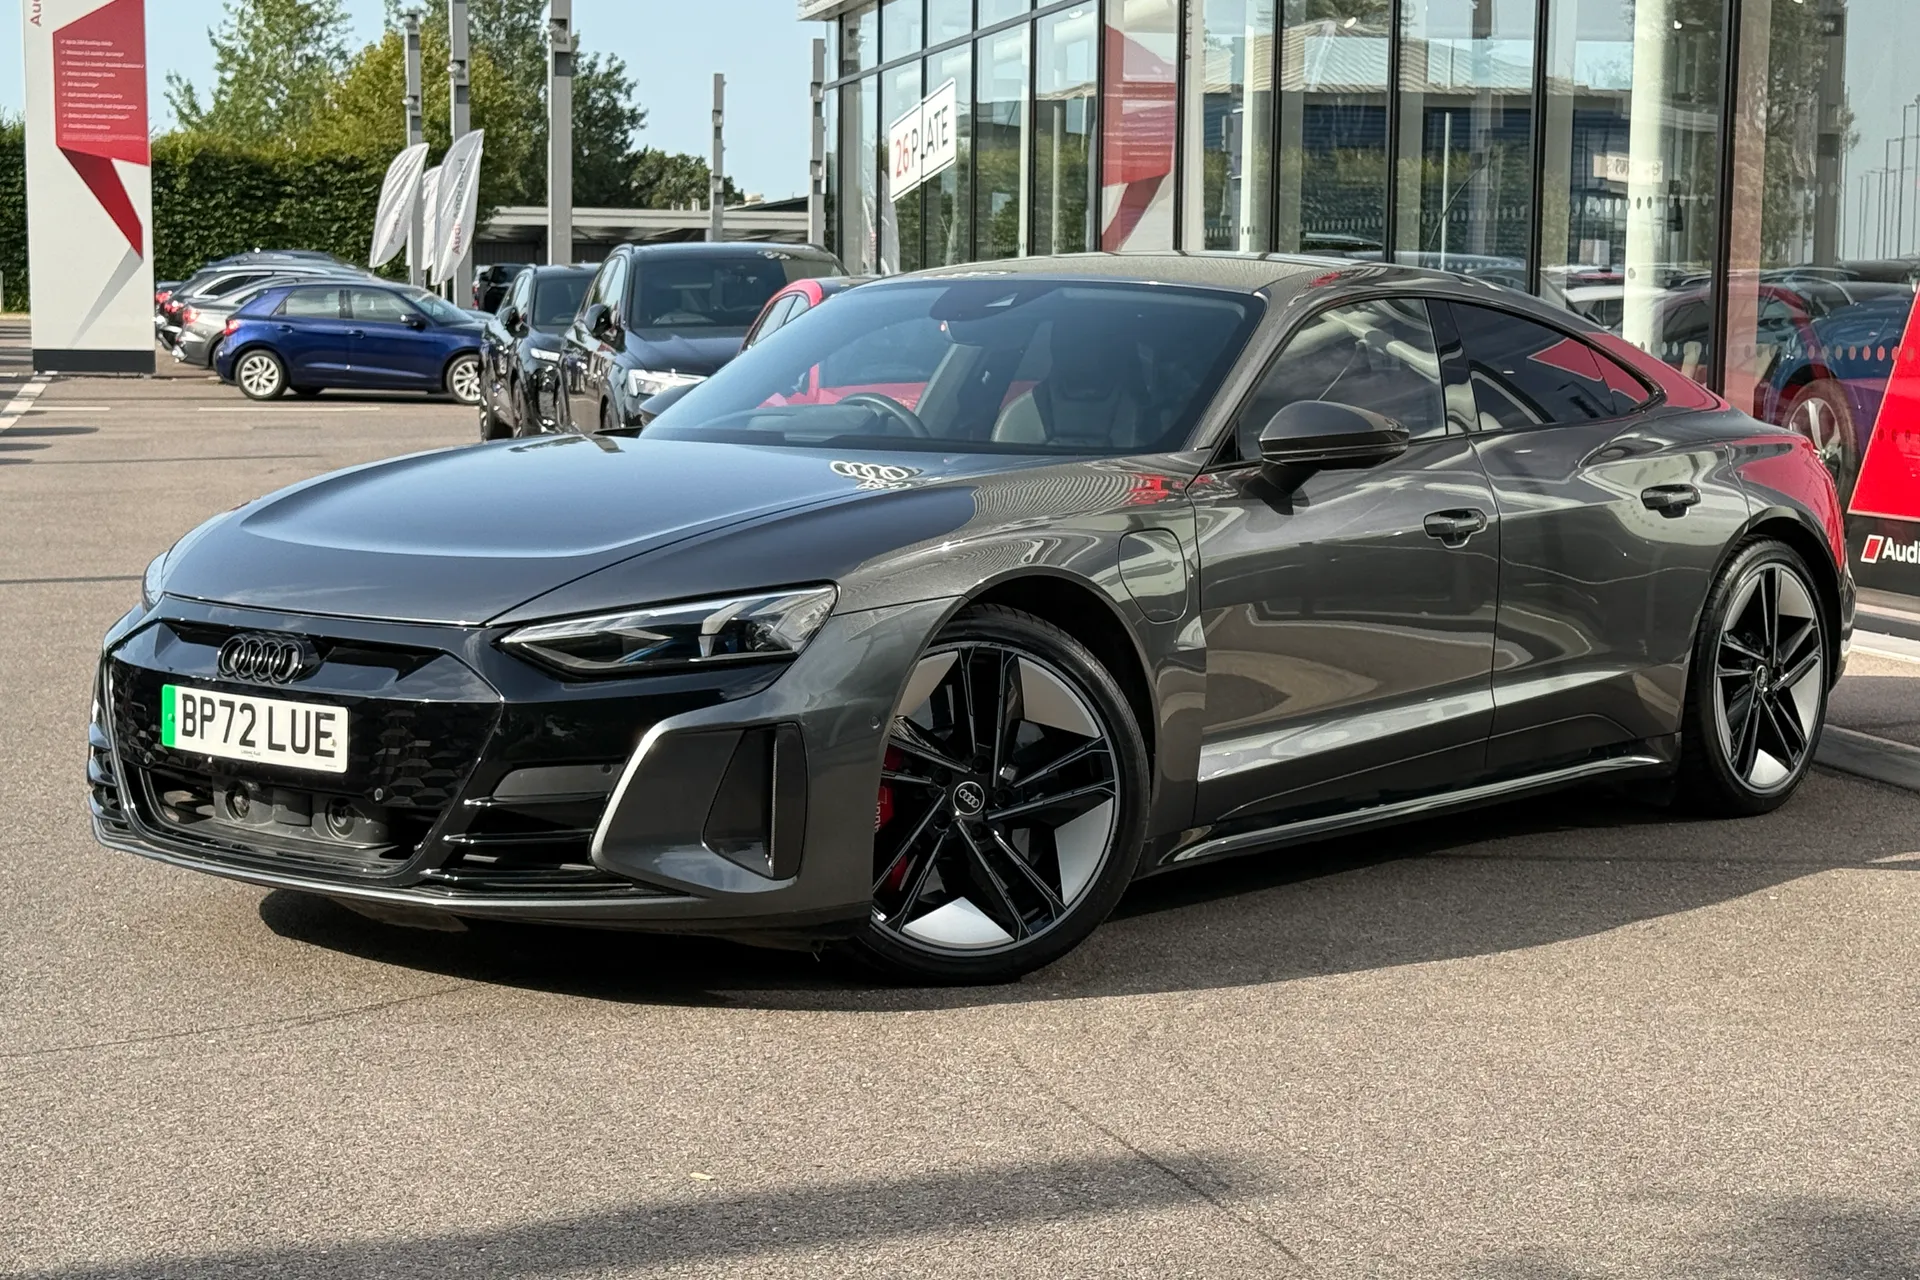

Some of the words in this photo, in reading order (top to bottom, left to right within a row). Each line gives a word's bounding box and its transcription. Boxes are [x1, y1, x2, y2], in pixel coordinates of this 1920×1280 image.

[30, 0, 42, 27] Au
[181, 692, 257, 748] BP72
[267, 704, 337, 759] LUE
